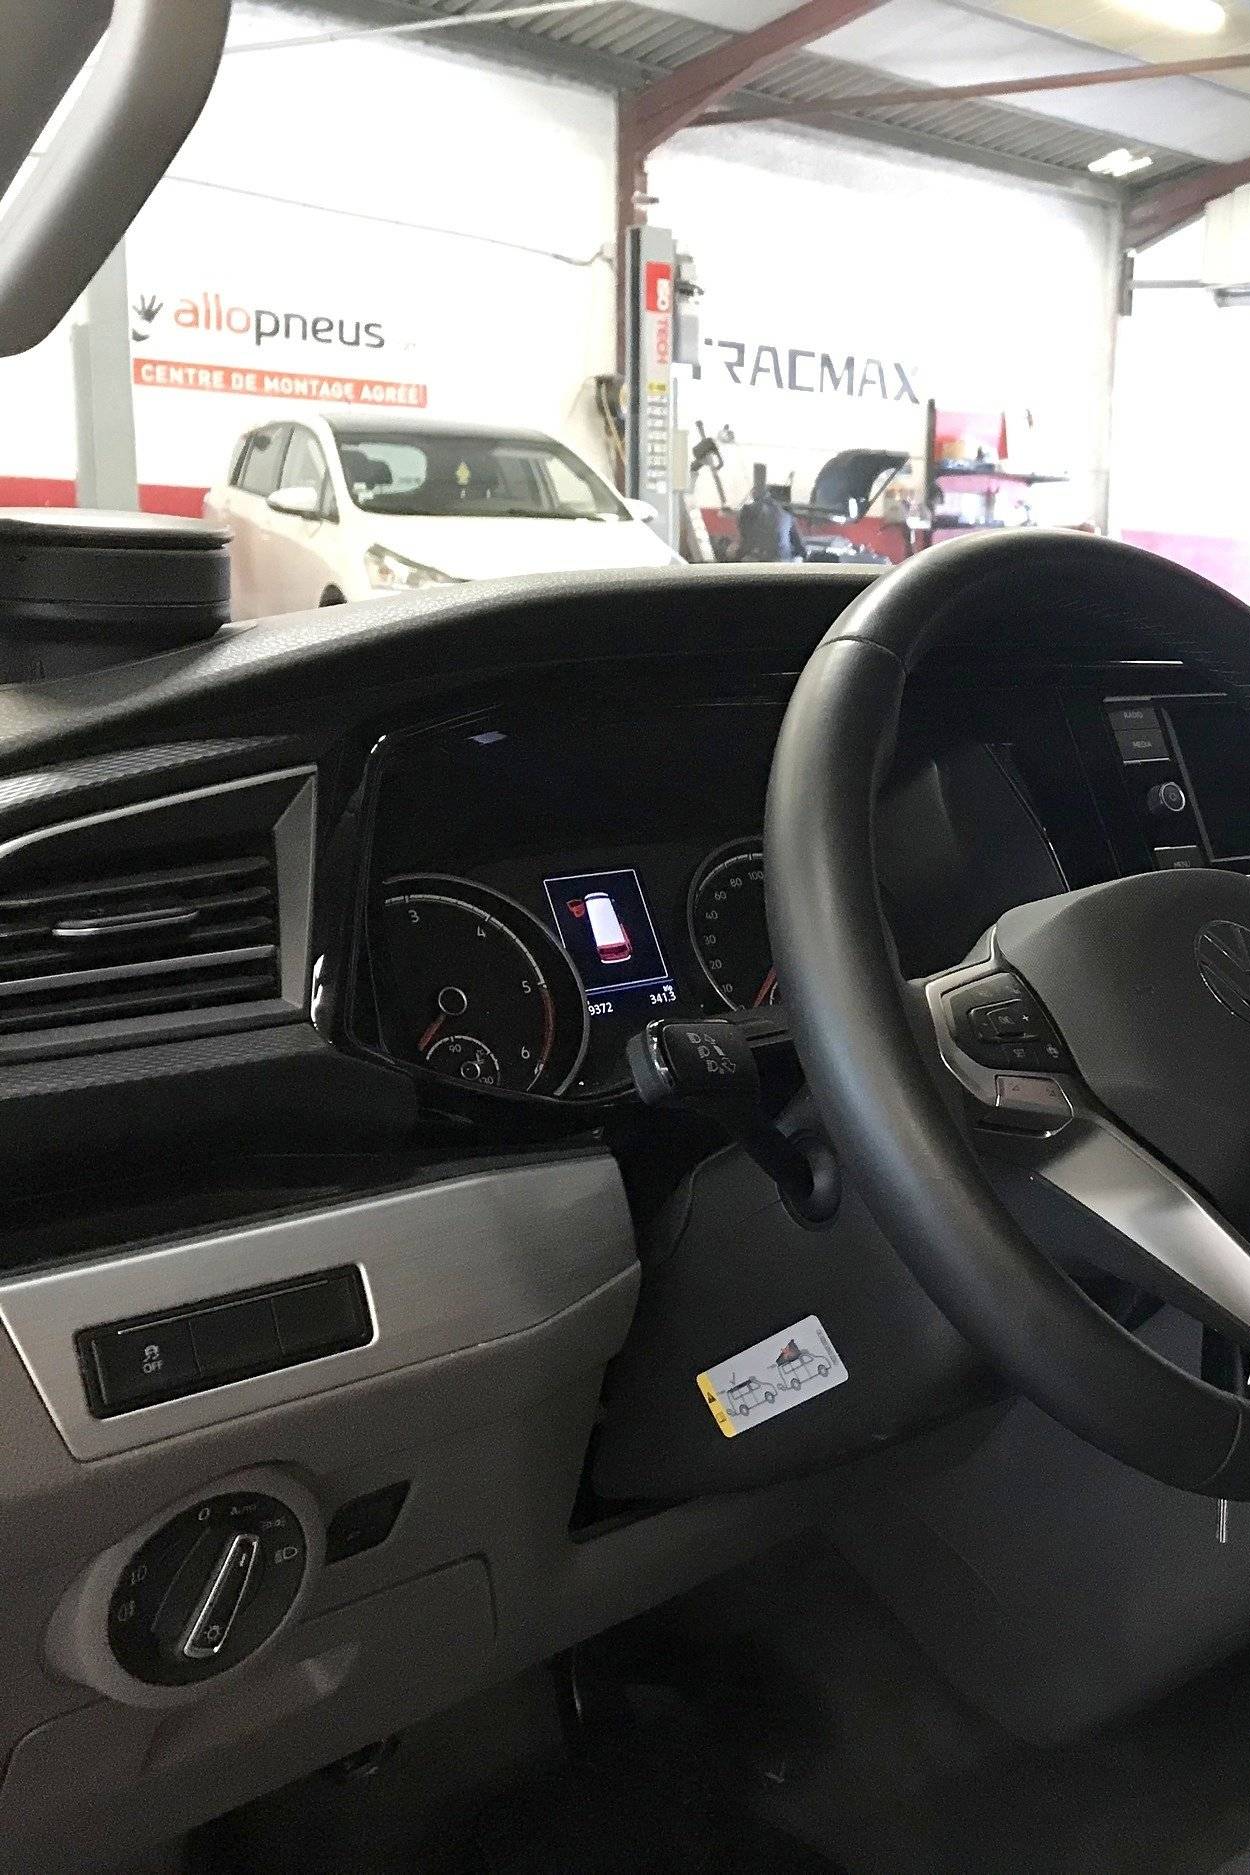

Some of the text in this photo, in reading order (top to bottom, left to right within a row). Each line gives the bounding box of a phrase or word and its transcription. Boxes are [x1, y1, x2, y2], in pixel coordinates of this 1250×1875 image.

[174, 291, 385, 349] allopneus
[140, 363, 225, 389] CENTRE
[230, 372, 257, 393] DE
[264, 375, 354, 401] MONTAGE
[1123, 711, 1144, 720] RADIO
[747, 872, 763, 881] 100
[729, 877, 743, 889] 80
[713, 890, 727, 901] 60
[408, 910, 420, 923] 3
[704, 910, 719, 921] 40
[476, 925, 486, 938] 4
[703, 934, 717, 945] 30
[708, 960, 721, 970] 20
[521, 980, 532, 994] 5
[521, 1045, 531, 1060] 6
[143, 1360, 163, 1374] OFF
